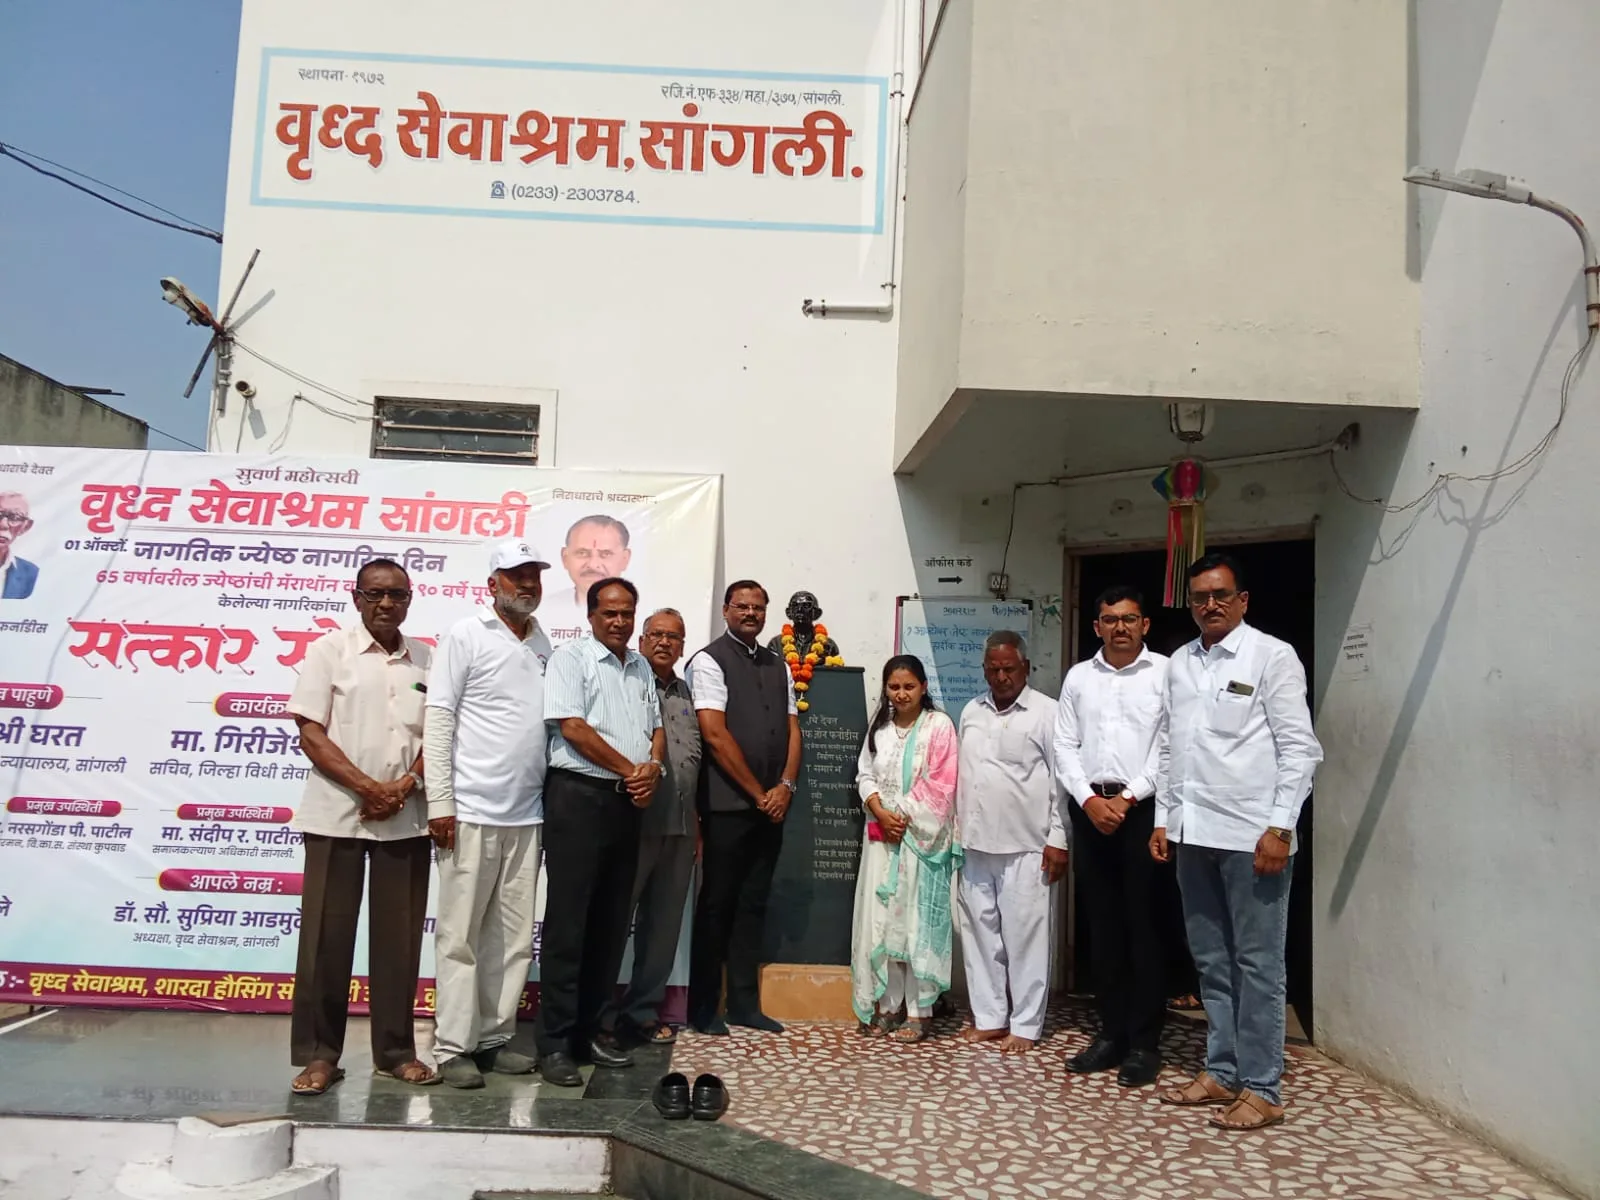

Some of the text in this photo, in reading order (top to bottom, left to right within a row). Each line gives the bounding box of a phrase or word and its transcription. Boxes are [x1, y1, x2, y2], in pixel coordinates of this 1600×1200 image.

[275, 102, 383, 180] वृध्द
[236, 467, 360, 485] सुवर्ण महोत्सवी
[81, 479, 531, 538] वृध्द सेवाश्रम सांगली
[64, 539, 80, 551] 01
[134, 538, 235, 563] जागतिक
[238, 541, 298, 565] ज्येष्ठ
[402, 547, 447, 573] दिन
[96, 570, 118, 584] 65
[202, 571, 276, 590] ज्येष्ठांची
[277, 574, 344, 592] मॅराथॉन
[417, 584, 437, 597] ९०
[442, 581, 468, 598] वर्षे
[218, 593, 348, 612] केलेल्या नागरिकांचा
[67, 617, 259, 676] सत्कार
[11, 686, 54, 708] पाहुणे
[229, 696, 289, 714] कार्यक्र
[30, 725, 86, 747] घरत
[170, 730, 205, 753] मा.
[75, 756, 127, 773] सांगली
[149, 759, 193, 778] सचिव,
[199, 760, 242, 779] जिल्हा
[245, 762, 278, 779] विधी
[26, 799, 103, 814] प्रमुख उपस्थिती
[196, 806, 274, 821] प्रमुख उपस्थिती
[69, 821, 86, 837] पी.
[91, 823, 133, 839] पाटील
[161, 823, 305, 845] मा. संदीप र. पाटील
[94, 842, 127, 854] कुपवाड
[218, 845, 259, 857] अधिकारी
[190, 873, 240, 890] आपले
[113, 901, 138, 923] डॉ.
[144, 901, 170, 924] सौ.
[177, 903, 237, 931] सुप्रिया
[242, 935, 280, 948] सांगली
[29, 972, 71, 997] वृध्द
[71, 969, 148, 997] सेवाश्रम,
[154, 977, 210, 999] शारदा
[214, 974, 273, 1000] हौसिंग
